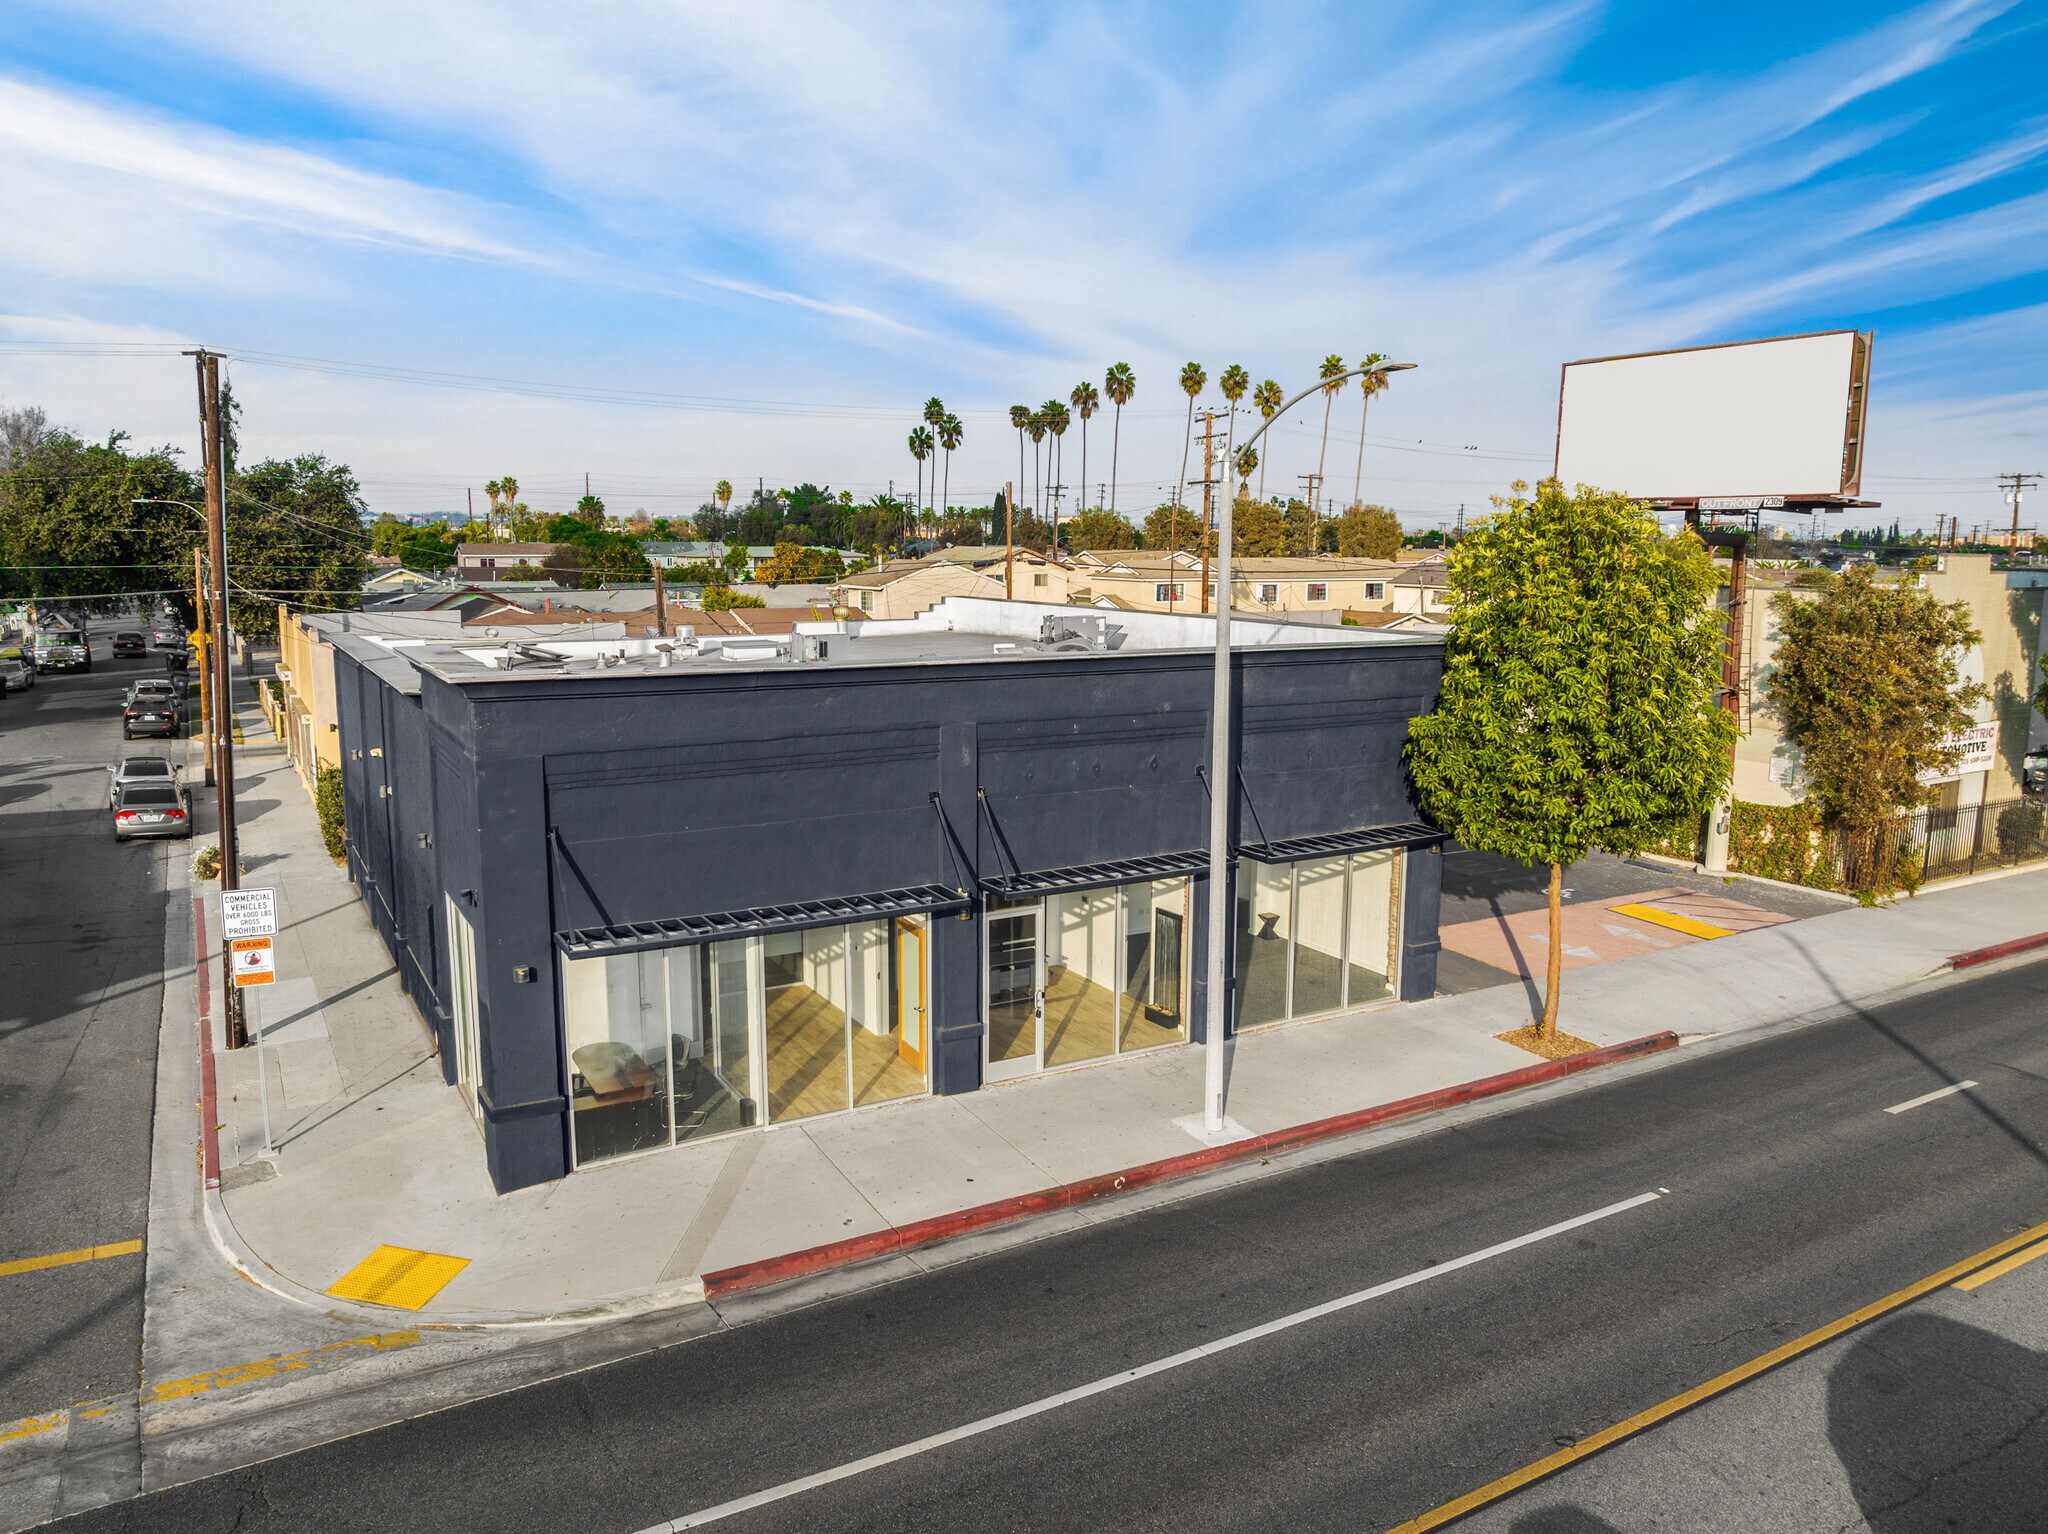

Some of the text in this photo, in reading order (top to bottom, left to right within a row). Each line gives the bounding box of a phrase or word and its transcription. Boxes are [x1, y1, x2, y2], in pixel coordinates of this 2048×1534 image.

[1765, 497, 1783, 506] 2309
[225, 893, 271, 904] COMMERCIAL
[230, 902, 268, 911] VEHICLES
[225, 912, 240, 920] OVER
[243, 911, 258, 919] 6000
[240, 918, 260, 926] GROSS
[229, 925, 272, 935] PROHIBITED
[236, 940, 267, 949] WARNING
